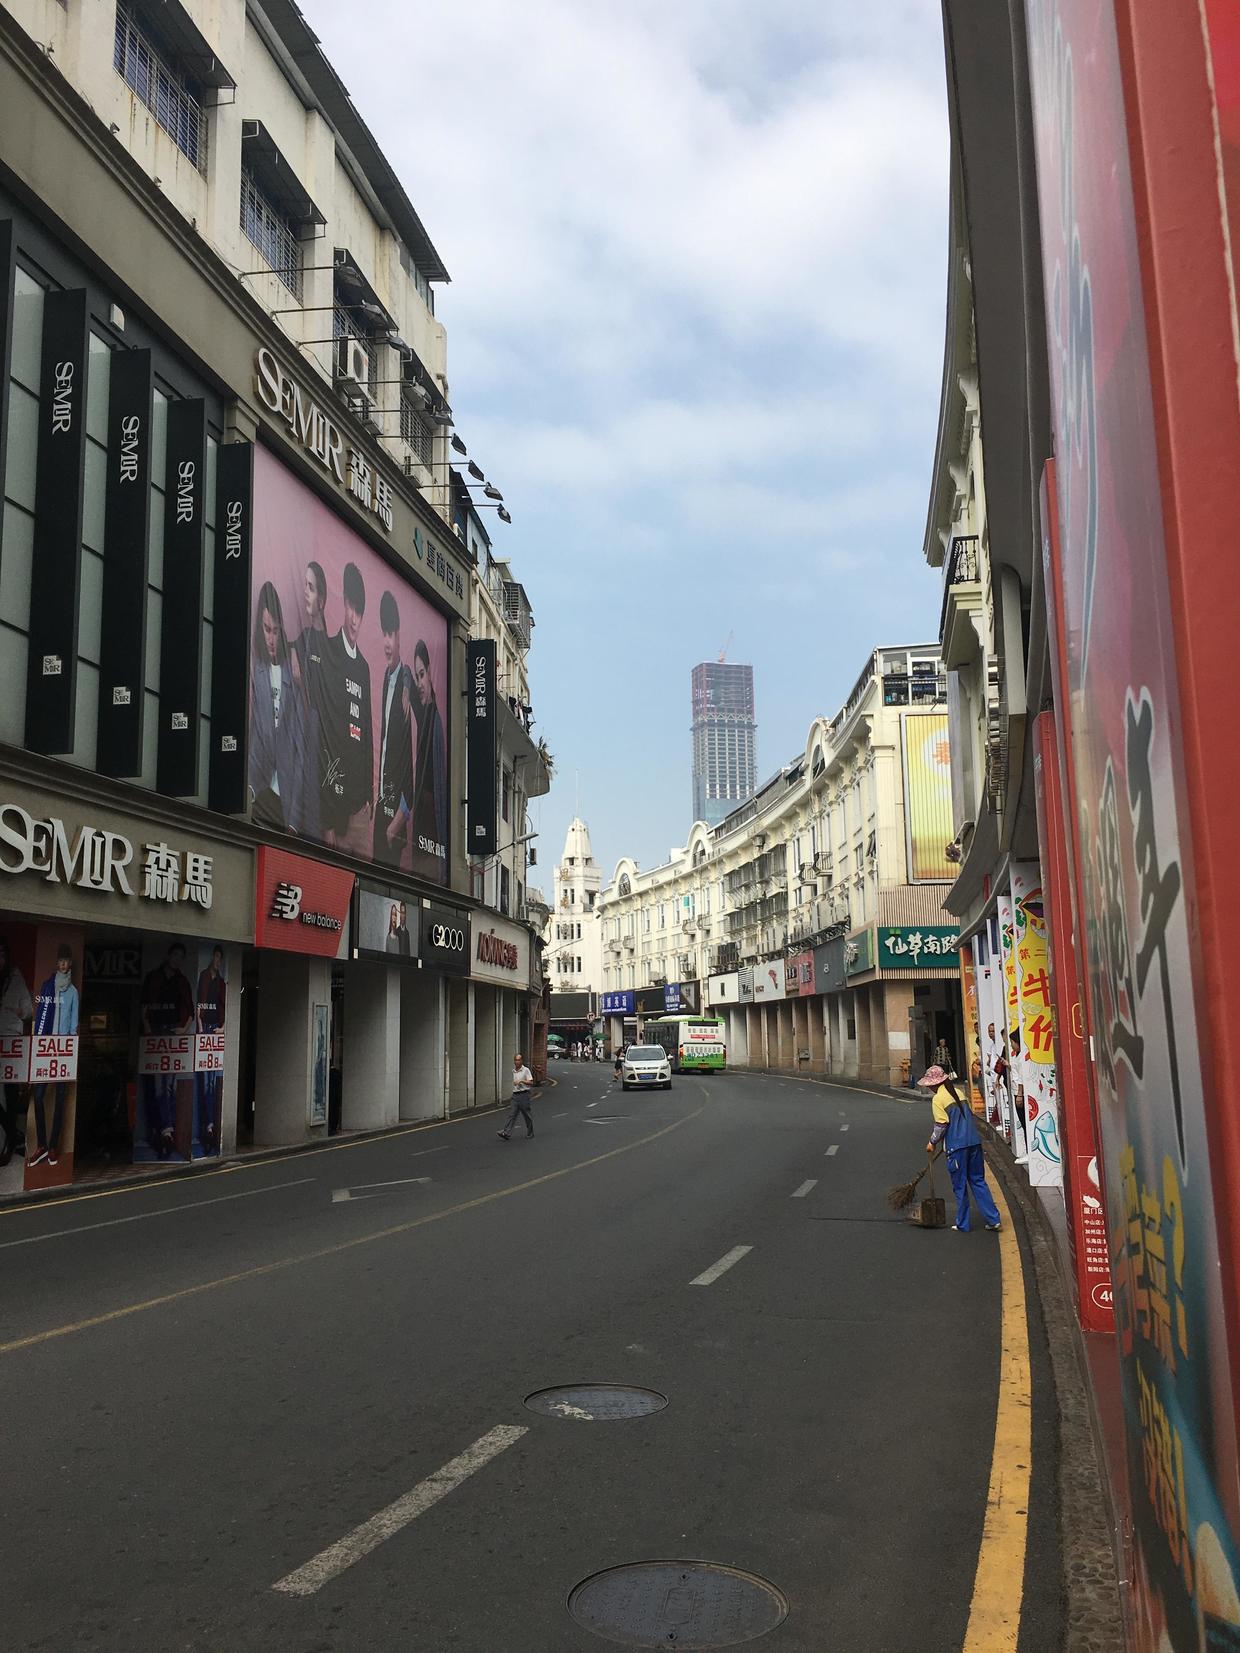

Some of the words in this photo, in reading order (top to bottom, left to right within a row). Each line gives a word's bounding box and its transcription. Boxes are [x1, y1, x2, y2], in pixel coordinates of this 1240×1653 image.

[52, 361, 74, 435] SEMIR
[120, 415, 140, 484] SEMIR
[257, 348, 344, 484] SEMIR
[347, 449, 393, 532] 森馬
[177, 461, 195, 525] SEMIR
[225, 501, 243, 560] SEMIR
[44, 665, 60, 673] MIR
[475, 656, 487, 695] SEMIR
[0, 804, 135, 895] SEMIR
[143, 842, 214, 910] 森馬
[418, 835, 436, 855] SEMIR
[302, 912, 316, 925] new
[316, 913, 342, 930] balance
[432, 924, 464, 951] G2000
[38, 1038, 74, 1053] SALE
[146, 1038, 189, 1051] SALE
[200, 1036, 224, 1048] SALE
